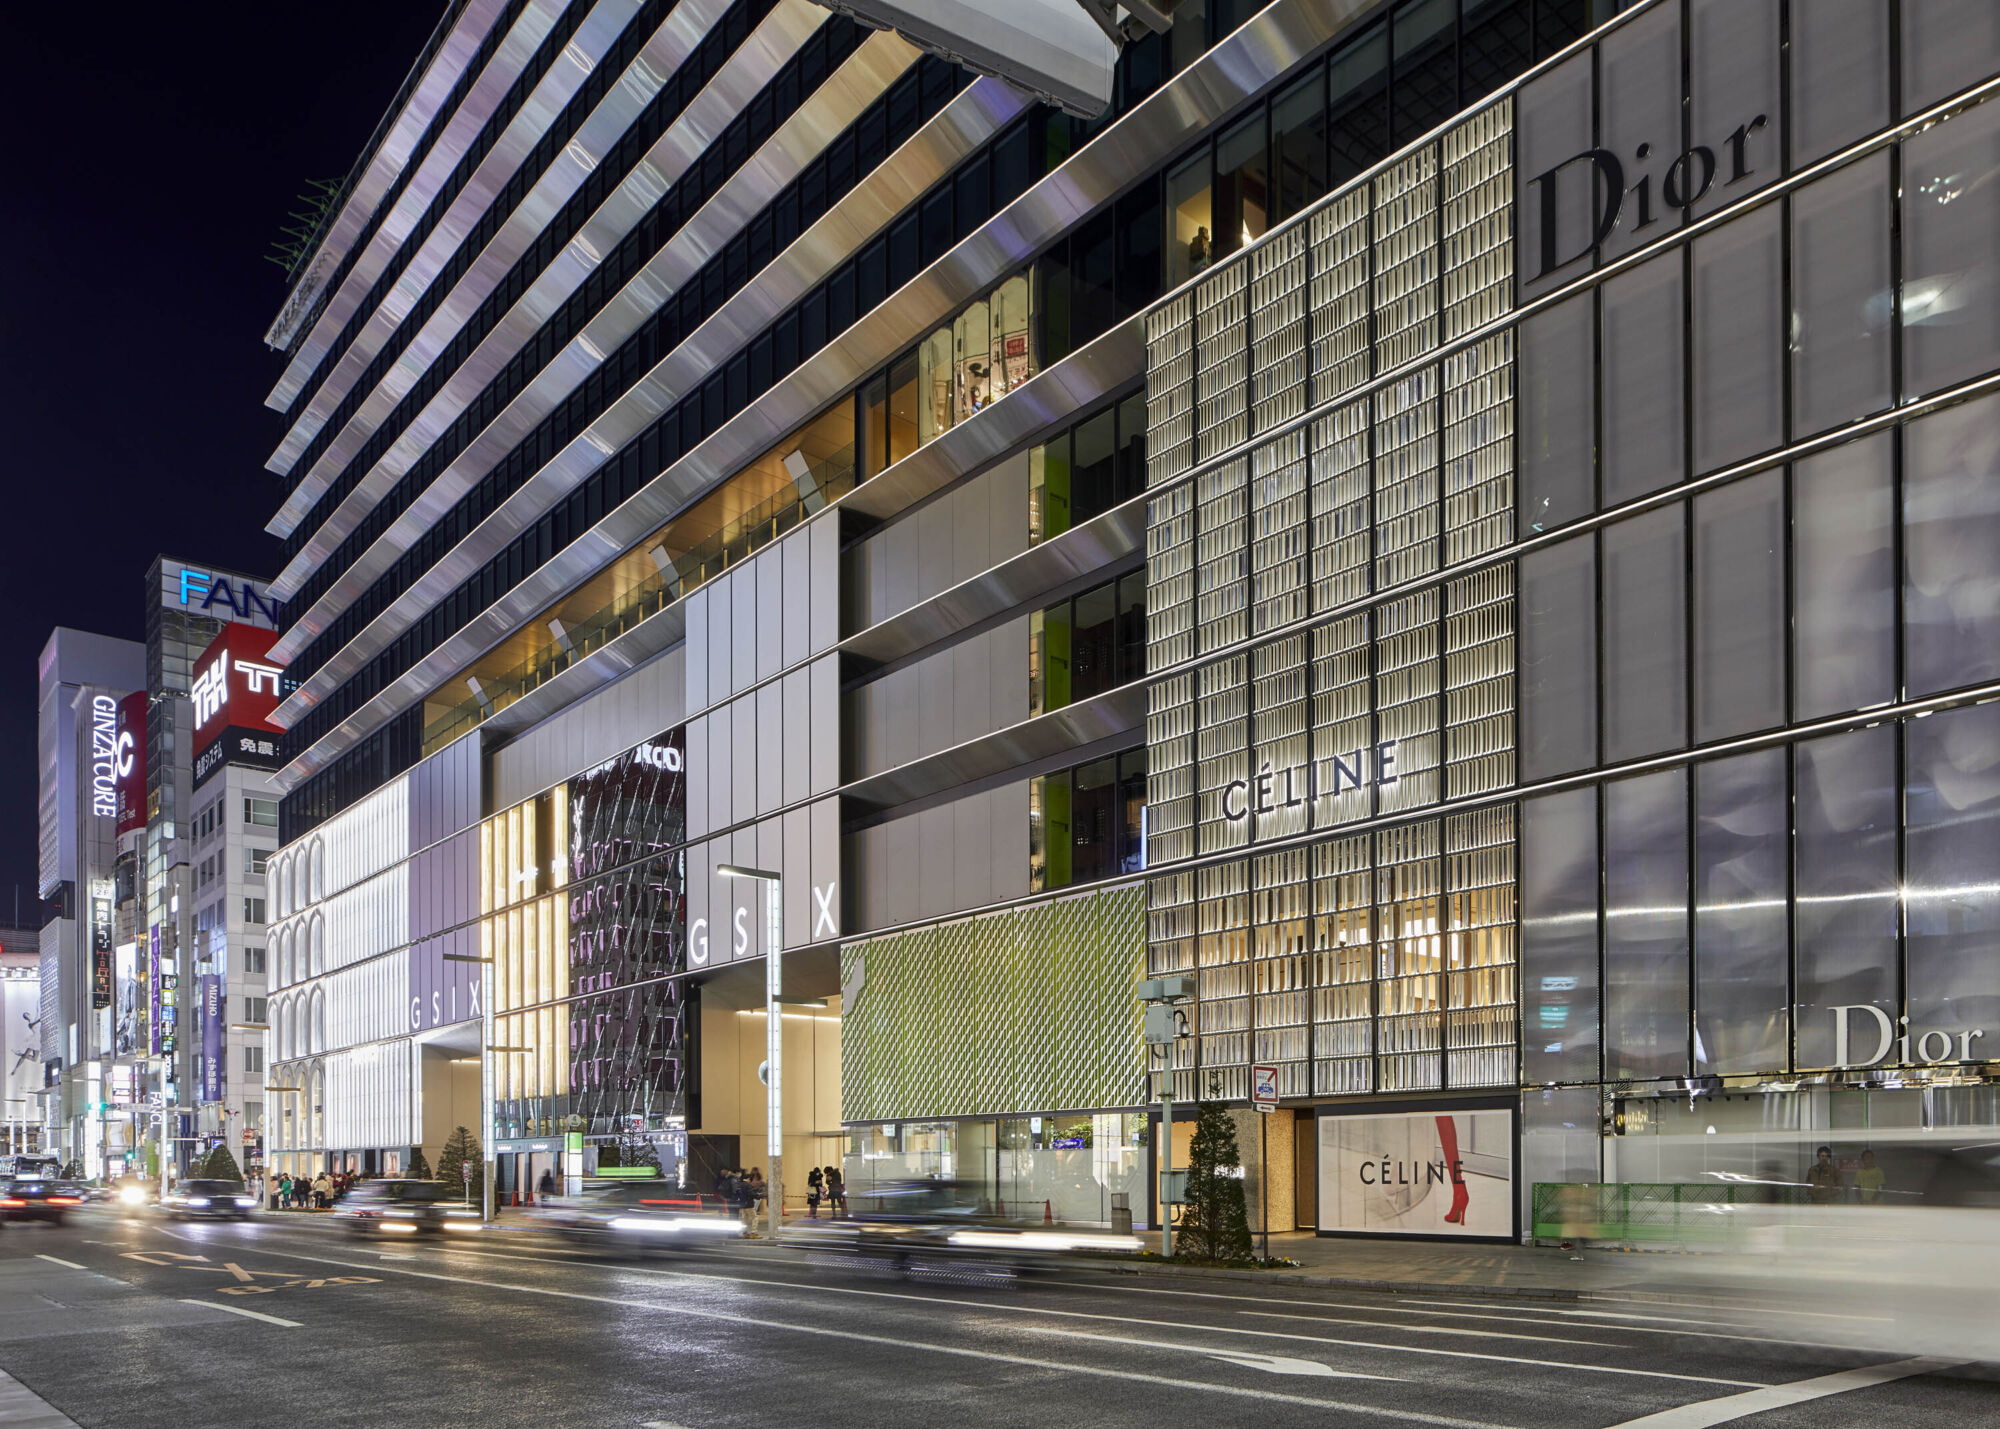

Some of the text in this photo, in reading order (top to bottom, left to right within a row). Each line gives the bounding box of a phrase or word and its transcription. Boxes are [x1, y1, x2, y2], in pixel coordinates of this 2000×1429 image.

[1524, 114, 1768, 286] Dior
[1222, 738, 1400, 822] CÉLINE
[690, 882, 837, 965] GSX
[209, 984, 218, 1017] MIZUHO
[1827, 1004, 1983, 1068] Dior
[150, 1091, 162, 1128] FANCL
[1359, 1154, 1466, 1185] CÉLINE
